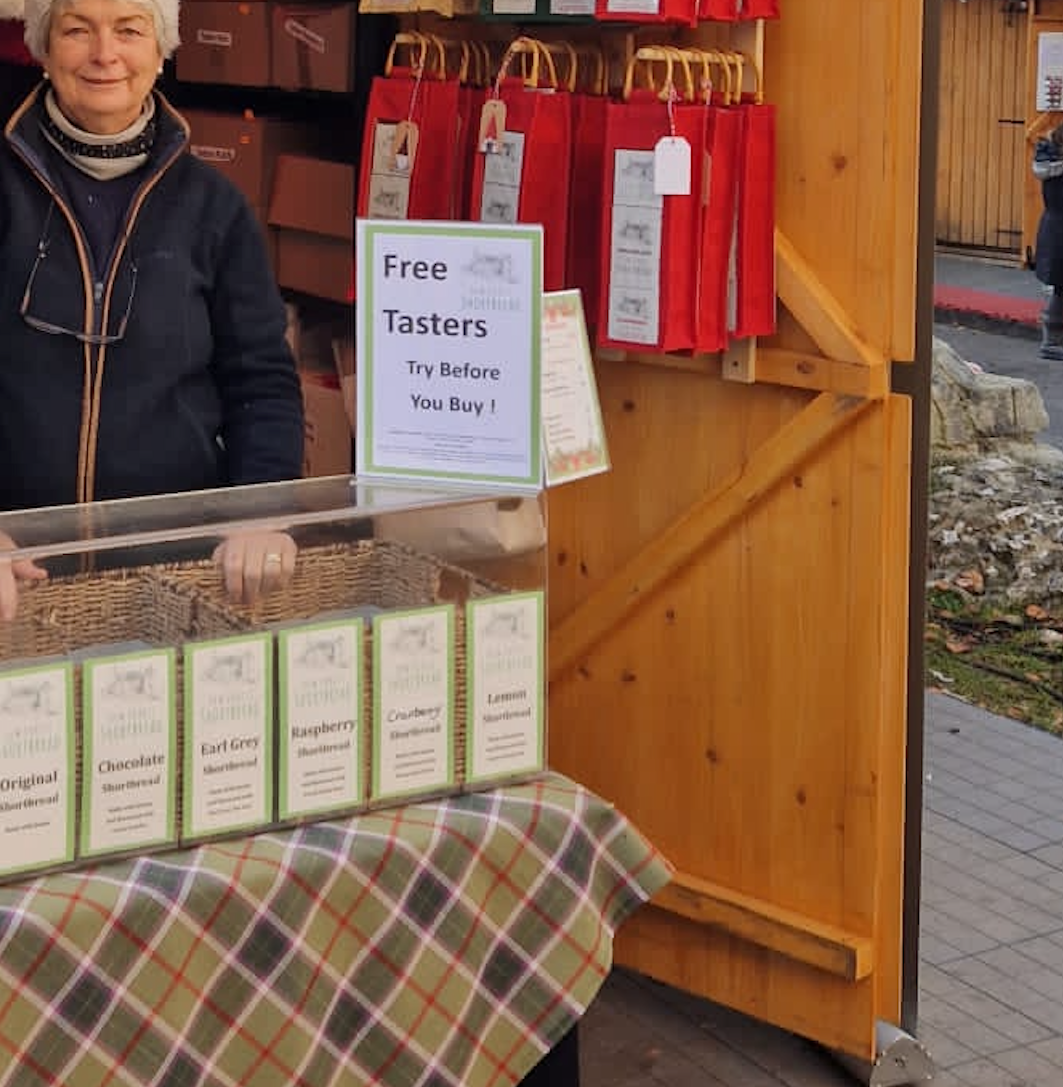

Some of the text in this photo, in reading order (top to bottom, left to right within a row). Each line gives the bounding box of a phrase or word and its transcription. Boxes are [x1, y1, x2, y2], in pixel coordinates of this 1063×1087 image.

[383, 254, 448, 280] Free
[383, 309, 488, 338] Tasters
[407, 360, 501, 381] Try Before
[410, 394, 443, 412] You
[450, 397, 485, 417] Buy
[291, 718, 357, 741] Raspberry
[201, 736, 260, 757] Earl Grey
[98, 753, 166, 775] Chocolate
[0, 770, 58, 794] Original
